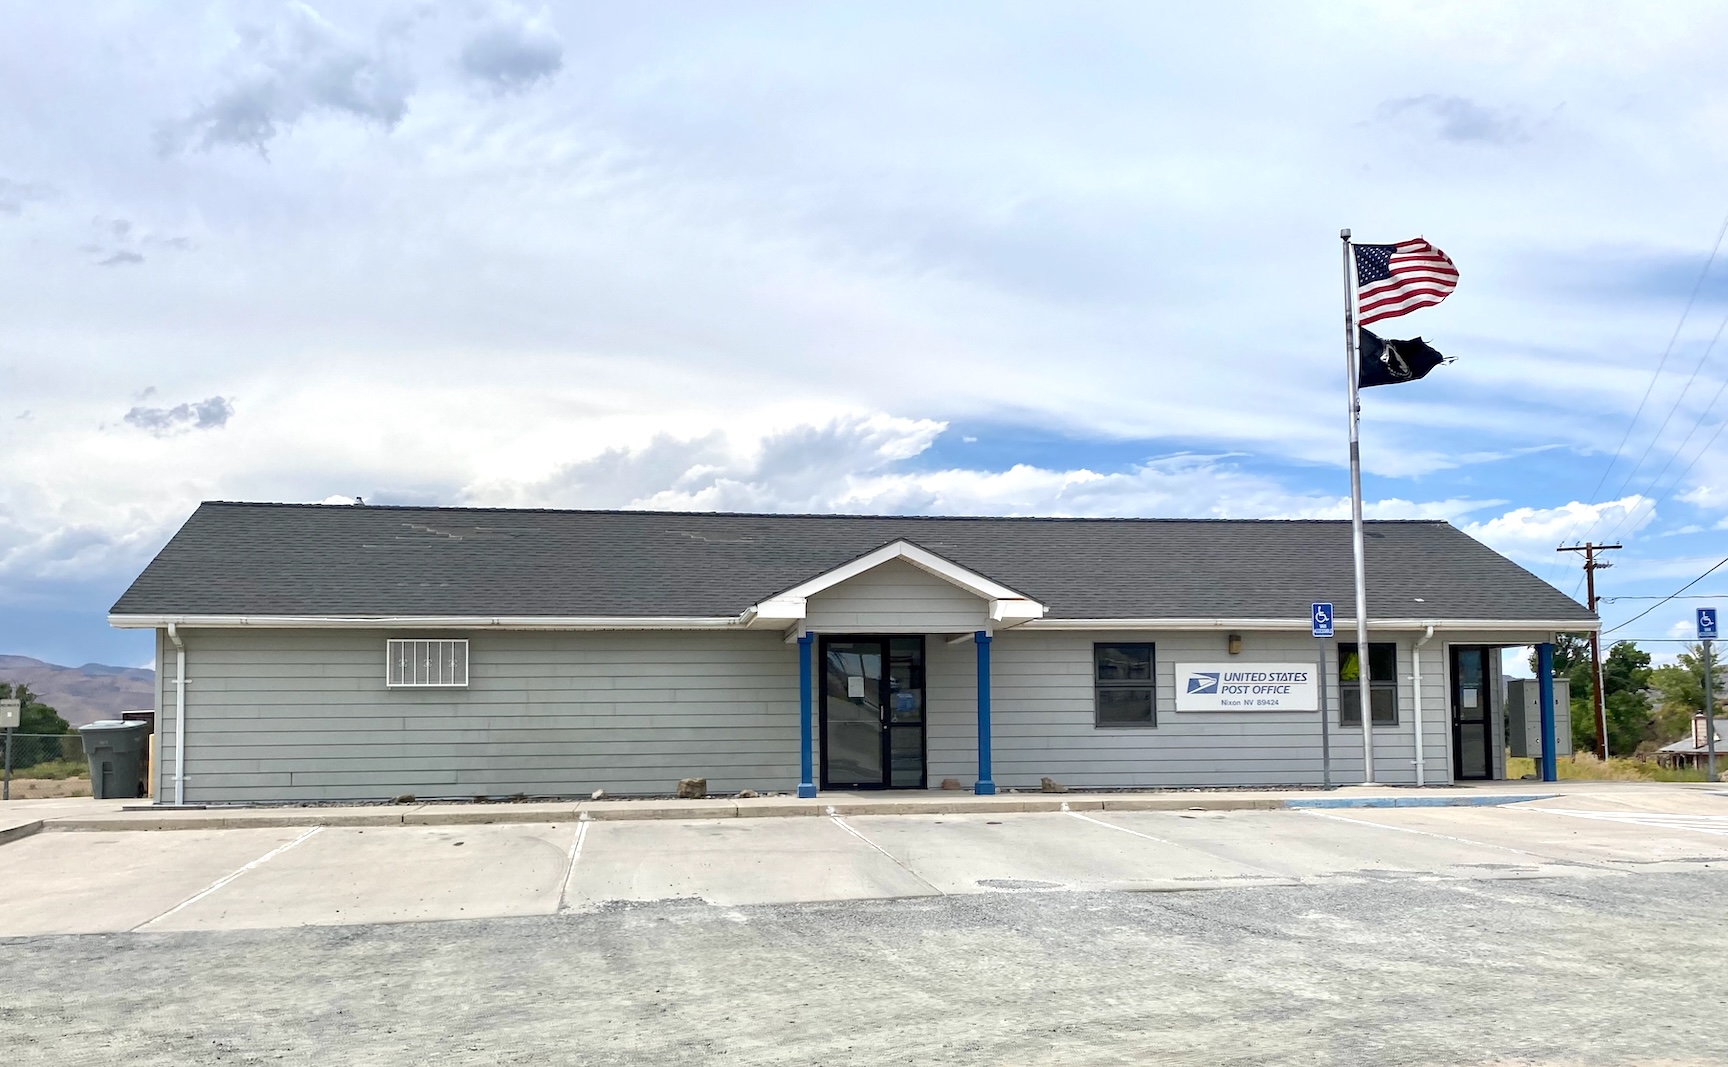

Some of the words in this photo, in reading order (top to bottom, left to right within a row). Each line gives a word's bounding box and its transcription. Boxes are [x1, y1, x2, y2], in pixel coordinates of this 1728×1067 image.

[1224, 672, 1266, 682] UNITED
[1268, 672, 1308, 682] STATES
[1222, 686, 1250, 694] POST
[1252, 686, 1290, 694] OFFICE
